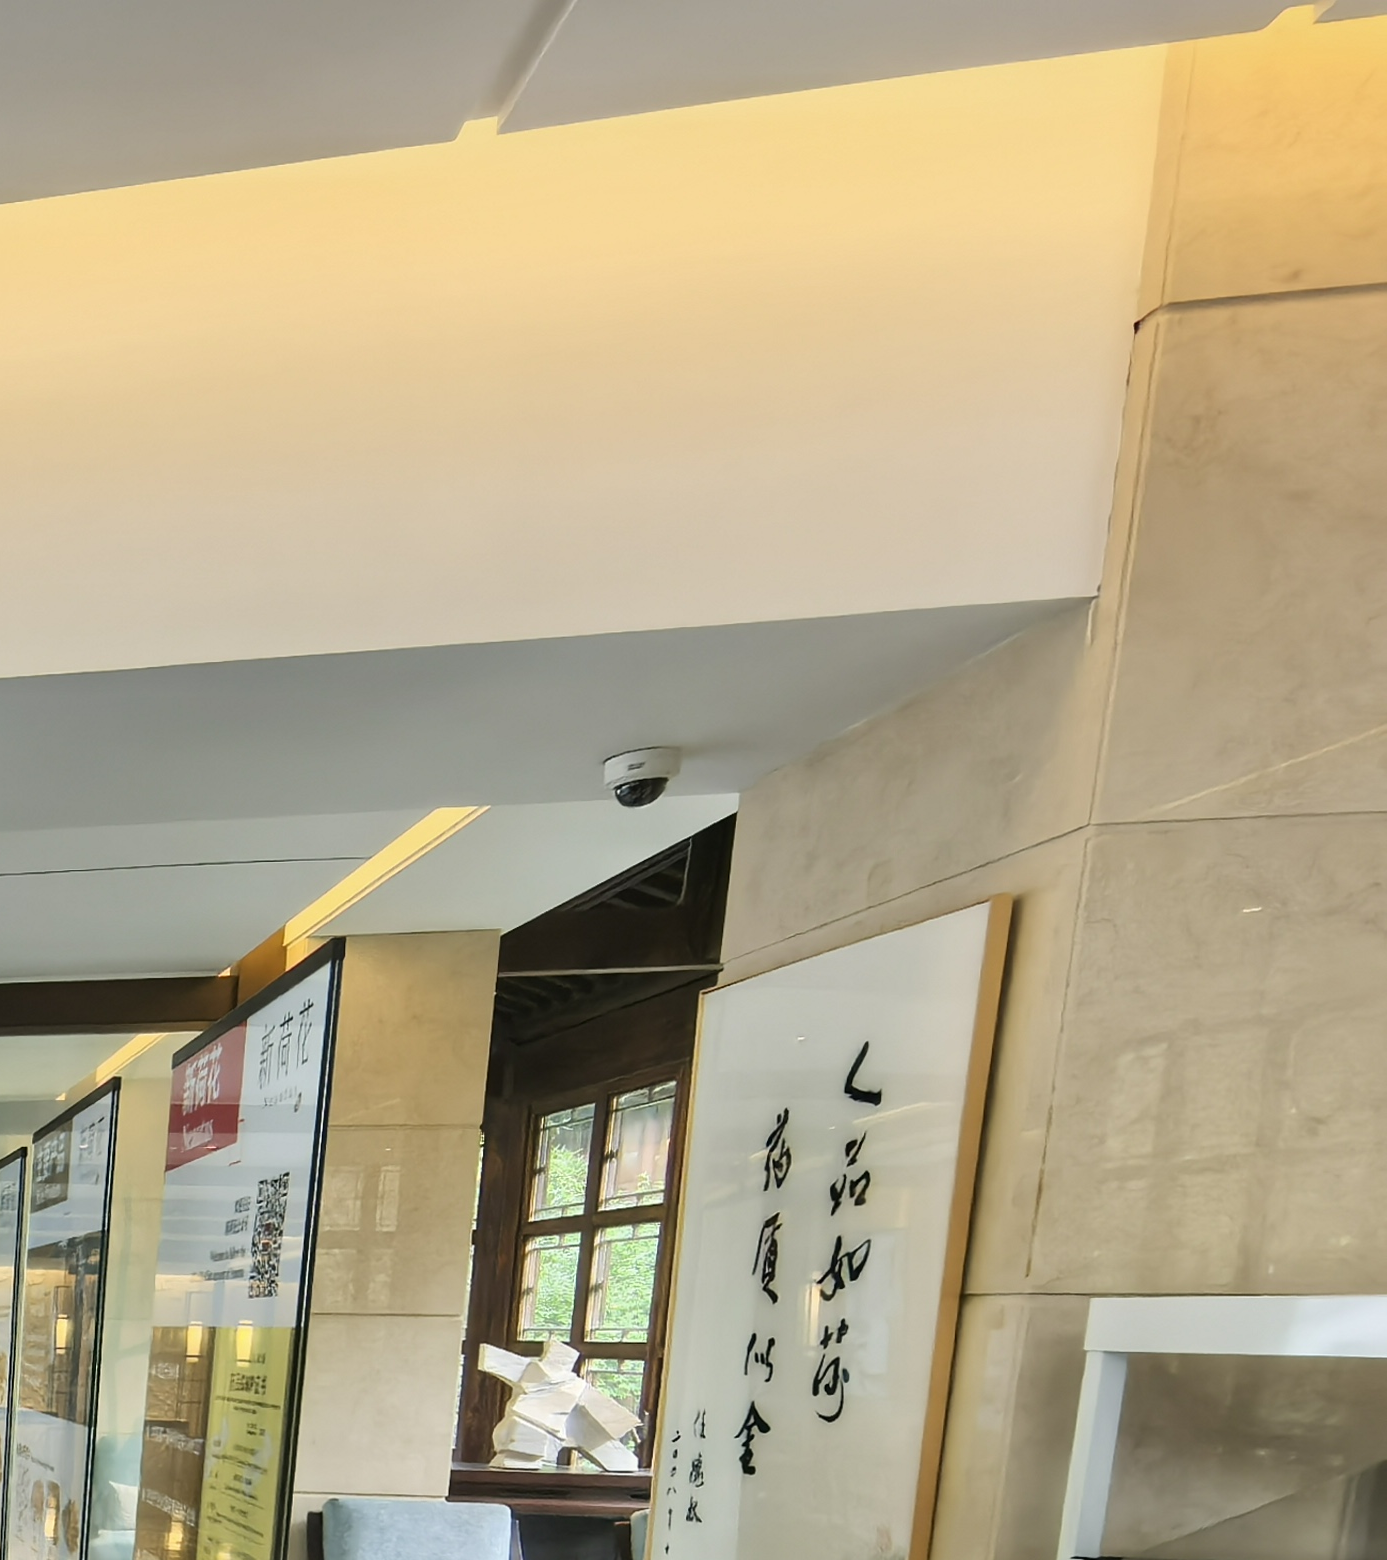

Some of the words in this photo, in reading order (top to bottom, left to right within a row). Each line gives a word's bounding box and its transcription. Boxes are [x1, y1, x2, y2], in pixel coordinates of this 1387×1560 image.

[182, 1043, 223, 1116] 新荷花
[258, 998, 314, 1089] 新荷花
